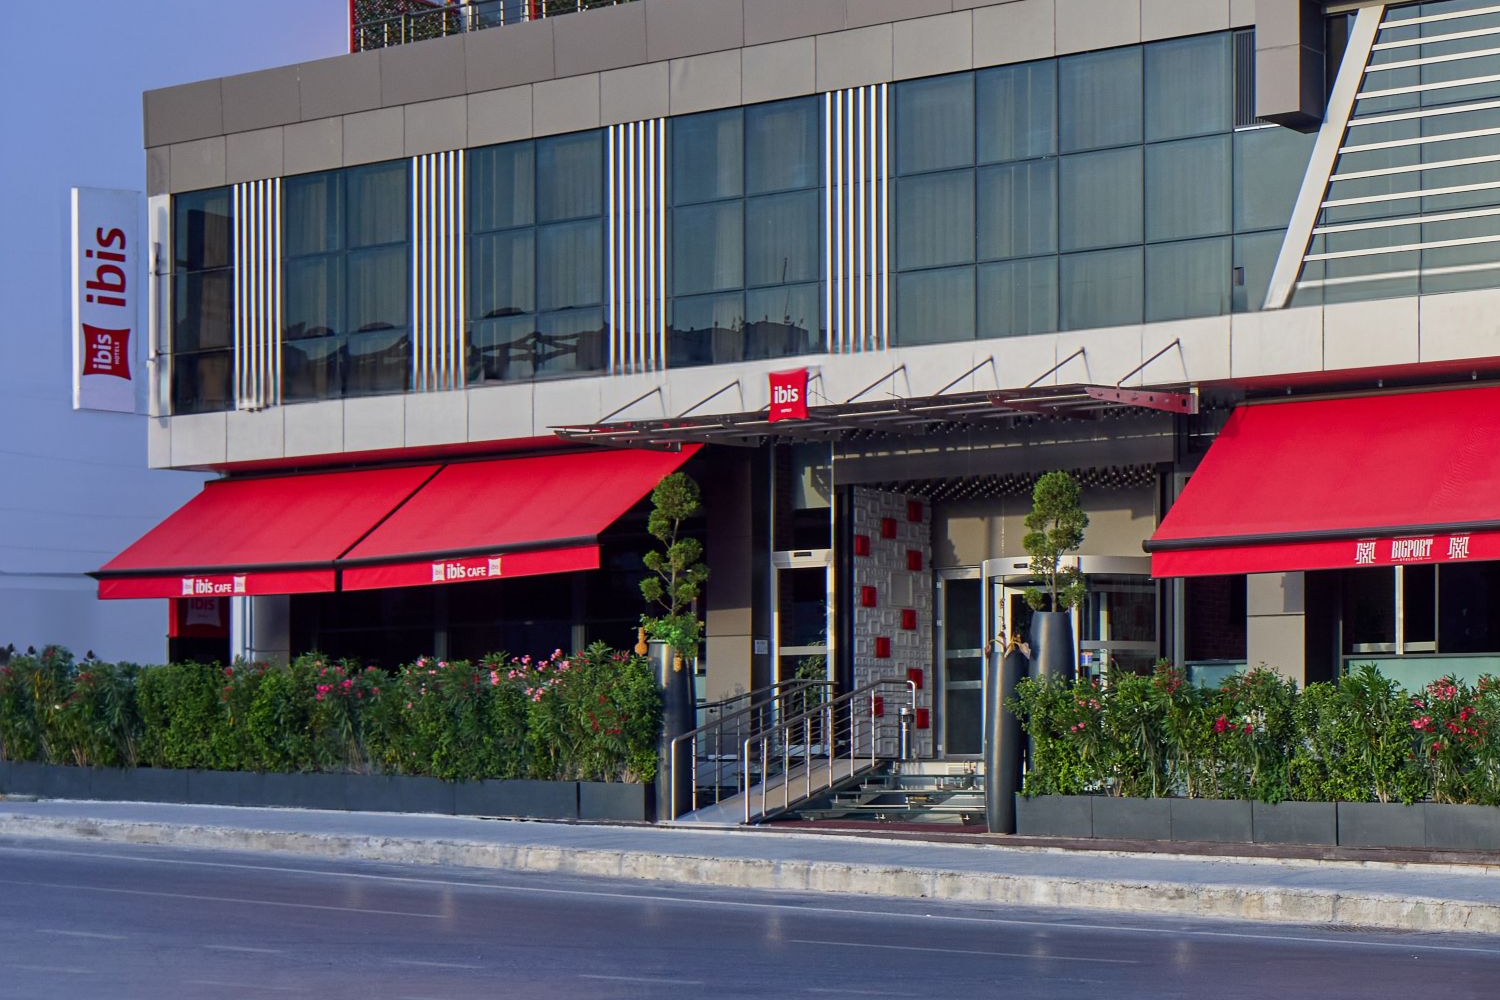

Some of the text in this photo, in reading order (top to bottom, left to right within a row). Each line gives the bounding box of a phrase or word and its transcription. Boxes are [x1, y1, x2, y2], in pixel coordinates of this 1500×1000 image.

[85, 227, 127, 307] ibis
[93, 334, 112, 370] ibis
[774, 385, 799, 404] ibis
[1391, 538, 1433, 559] BIGPORT
[447, 563, 465, 579] ibis
[195, 579, 213, 593] ibis
